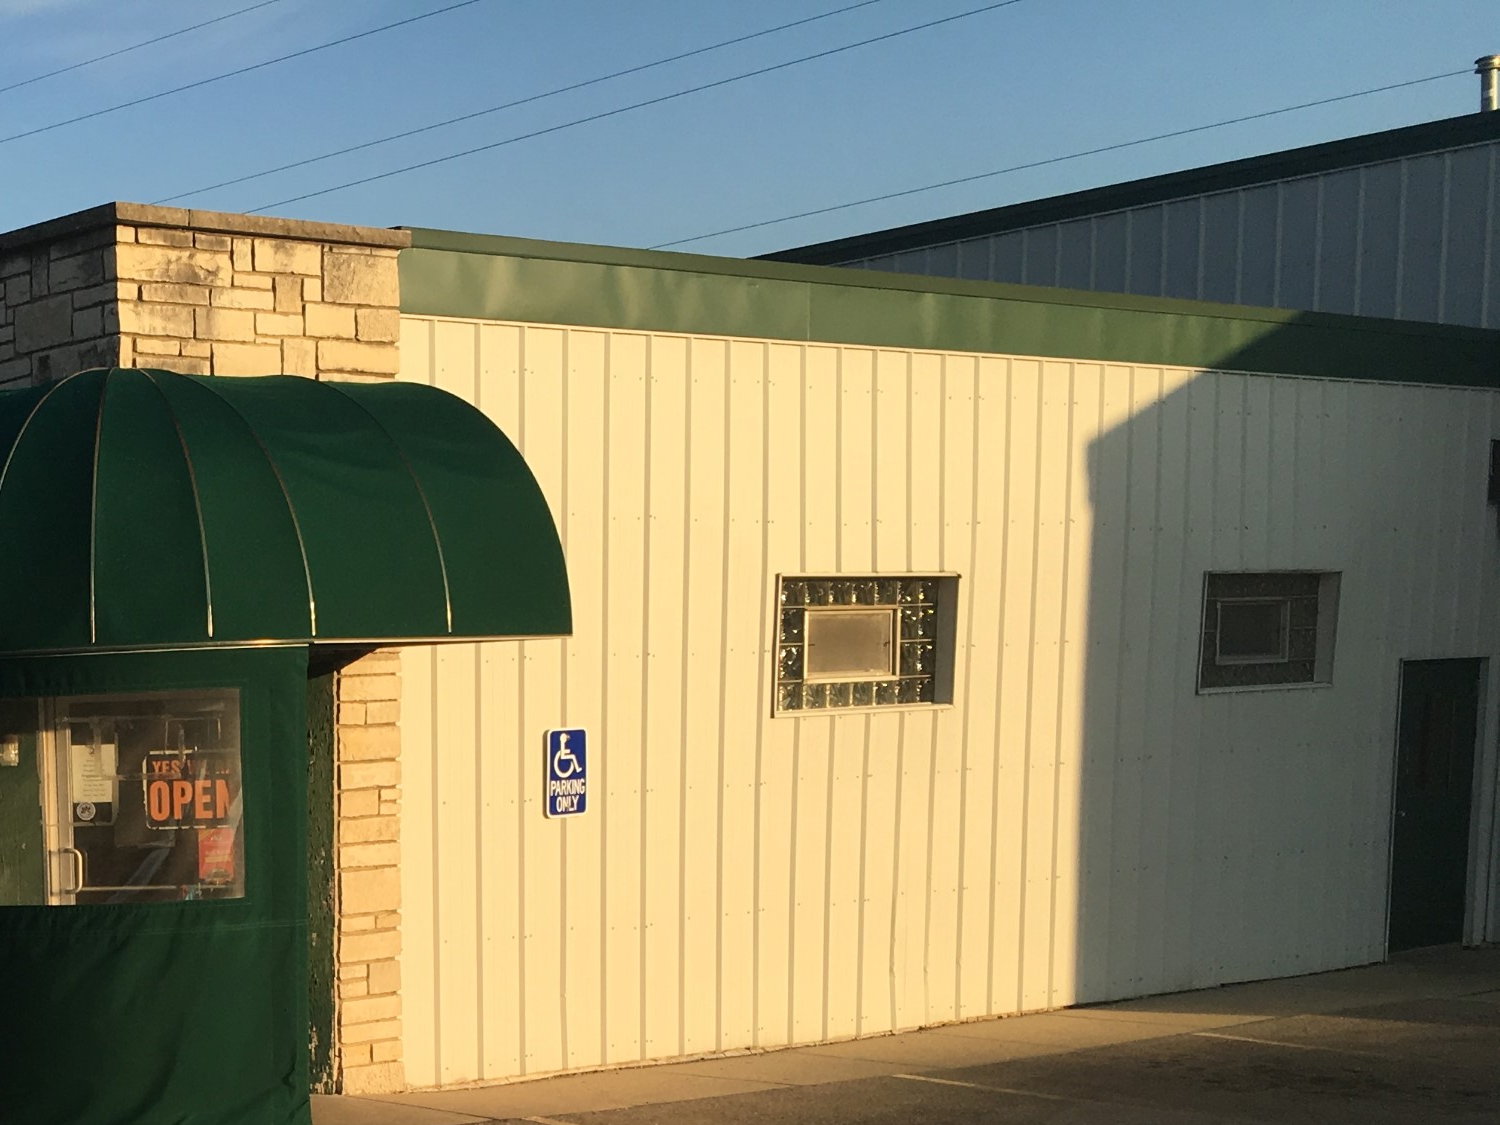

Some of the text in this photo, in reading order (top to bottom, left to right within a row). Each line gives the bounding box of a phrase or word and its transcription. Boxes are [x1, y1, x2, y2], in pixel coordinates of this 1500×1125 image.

[153, 760, 181, 774] YES
[551, 778, 585, 796] PARKING
[556, 795, 580, 812] ONLY
